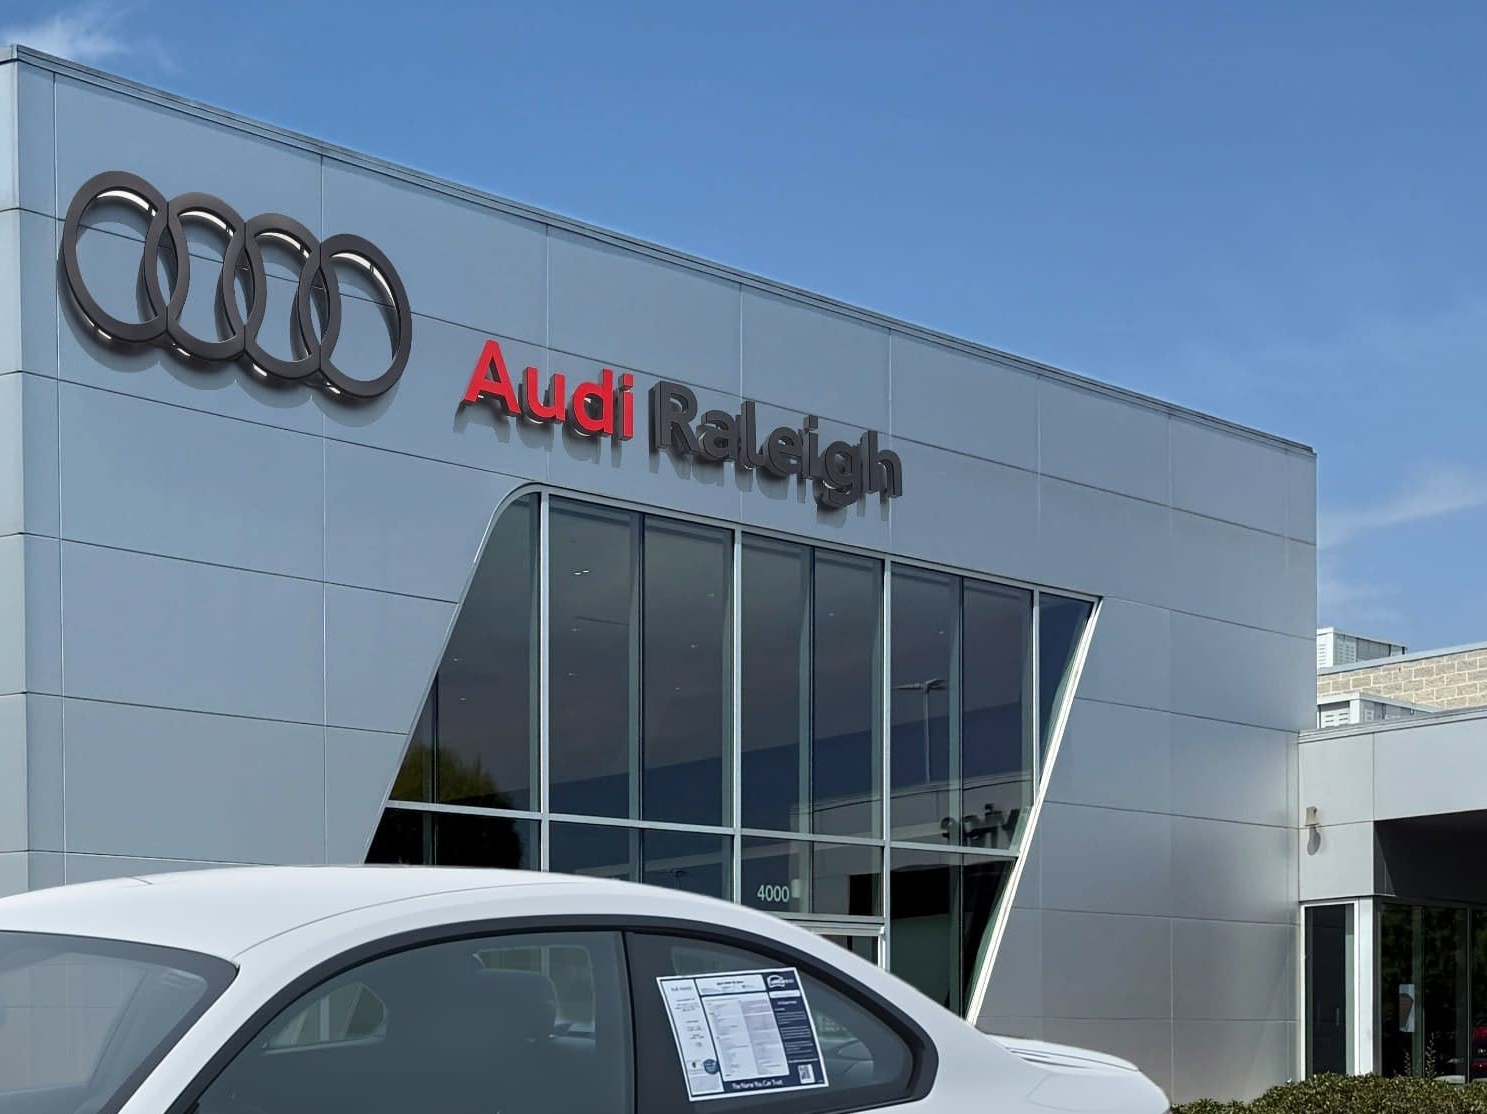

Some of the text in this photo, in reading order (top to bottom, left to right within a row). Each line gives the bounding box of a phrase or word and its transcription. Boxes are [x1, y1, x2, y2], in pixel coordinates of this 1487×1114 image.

[463, 339, 903, 509] Audi Raleigh
[756, 884, 790, 902] 4000
